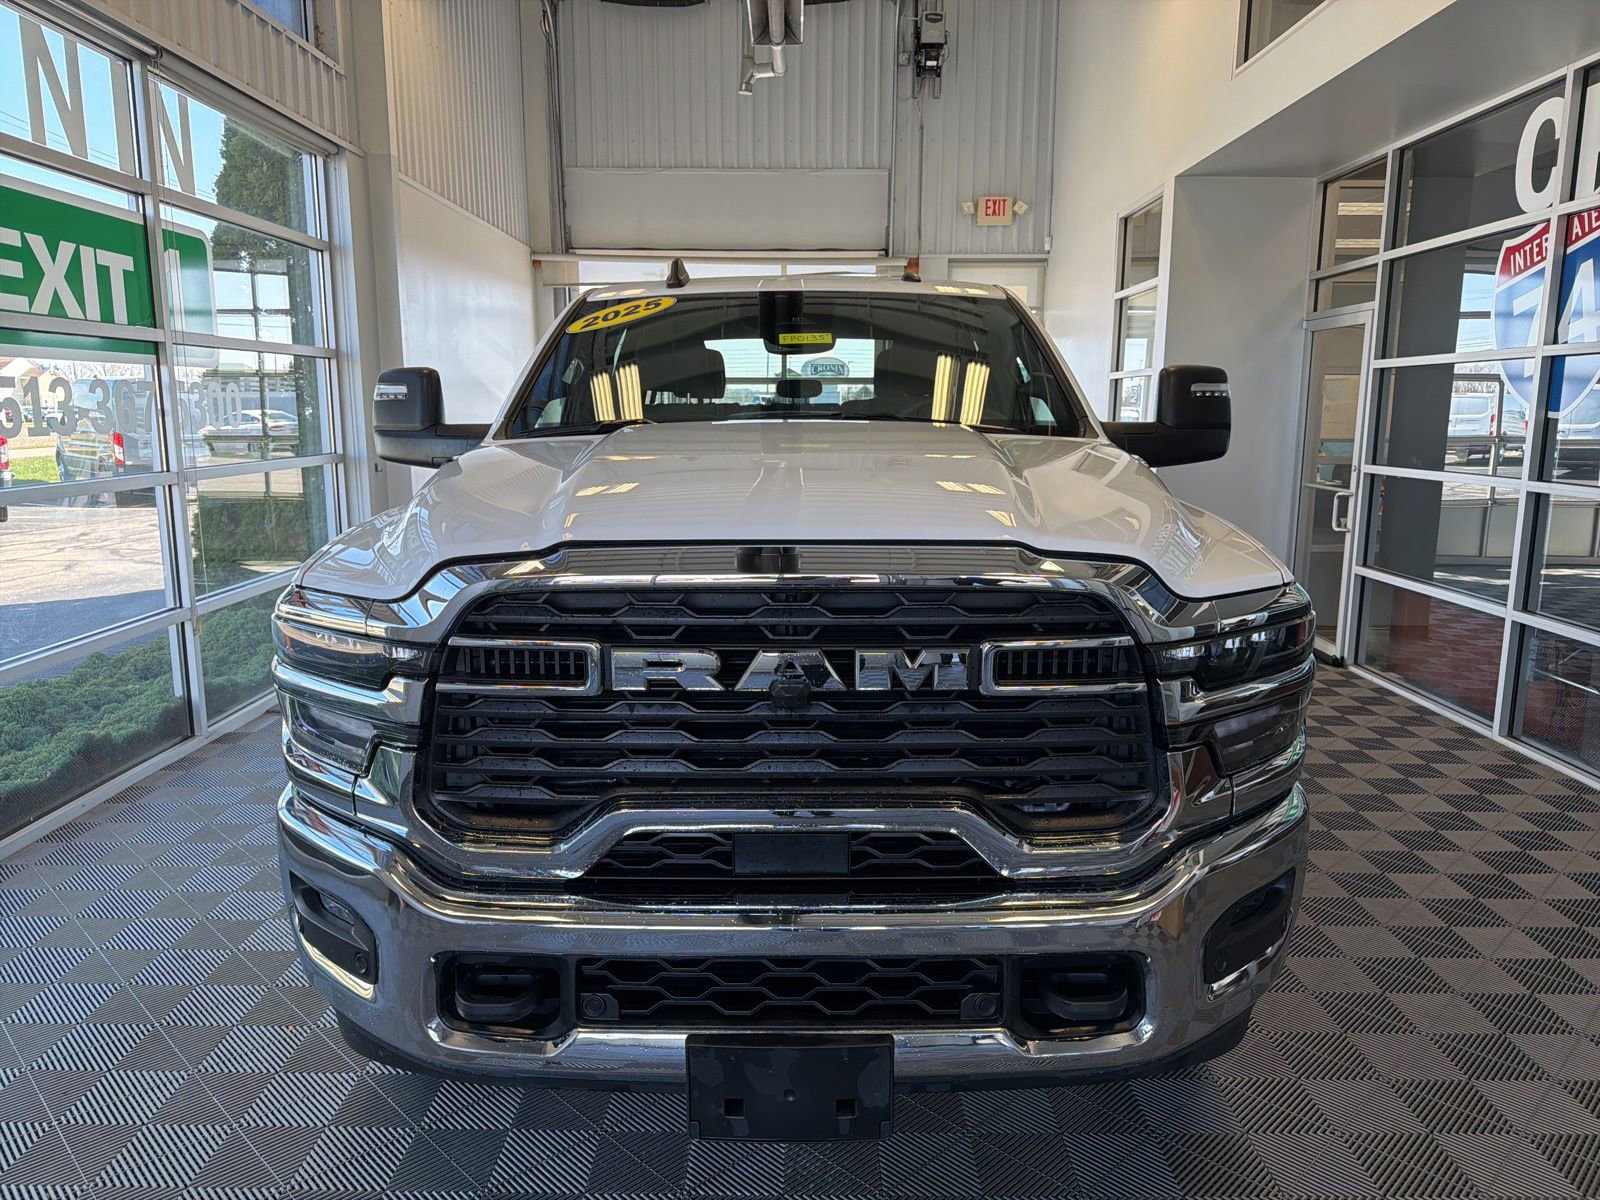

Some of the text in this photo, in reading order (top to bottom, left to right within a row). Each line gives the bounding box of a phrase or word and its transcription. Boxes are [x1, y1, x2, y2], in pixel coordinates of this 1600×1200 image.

[984, 198, 1008, 217] EXIT
[1510, 210, 1600, 276] INTERATE
[0, 226, 135, 325] EXIT
[580, 298, 663, 330] 2025
[1513, 258, 1600, 378] 74
[811, 363, 844, 375] CRONIN
[611, 647, 971, 692] RAM
